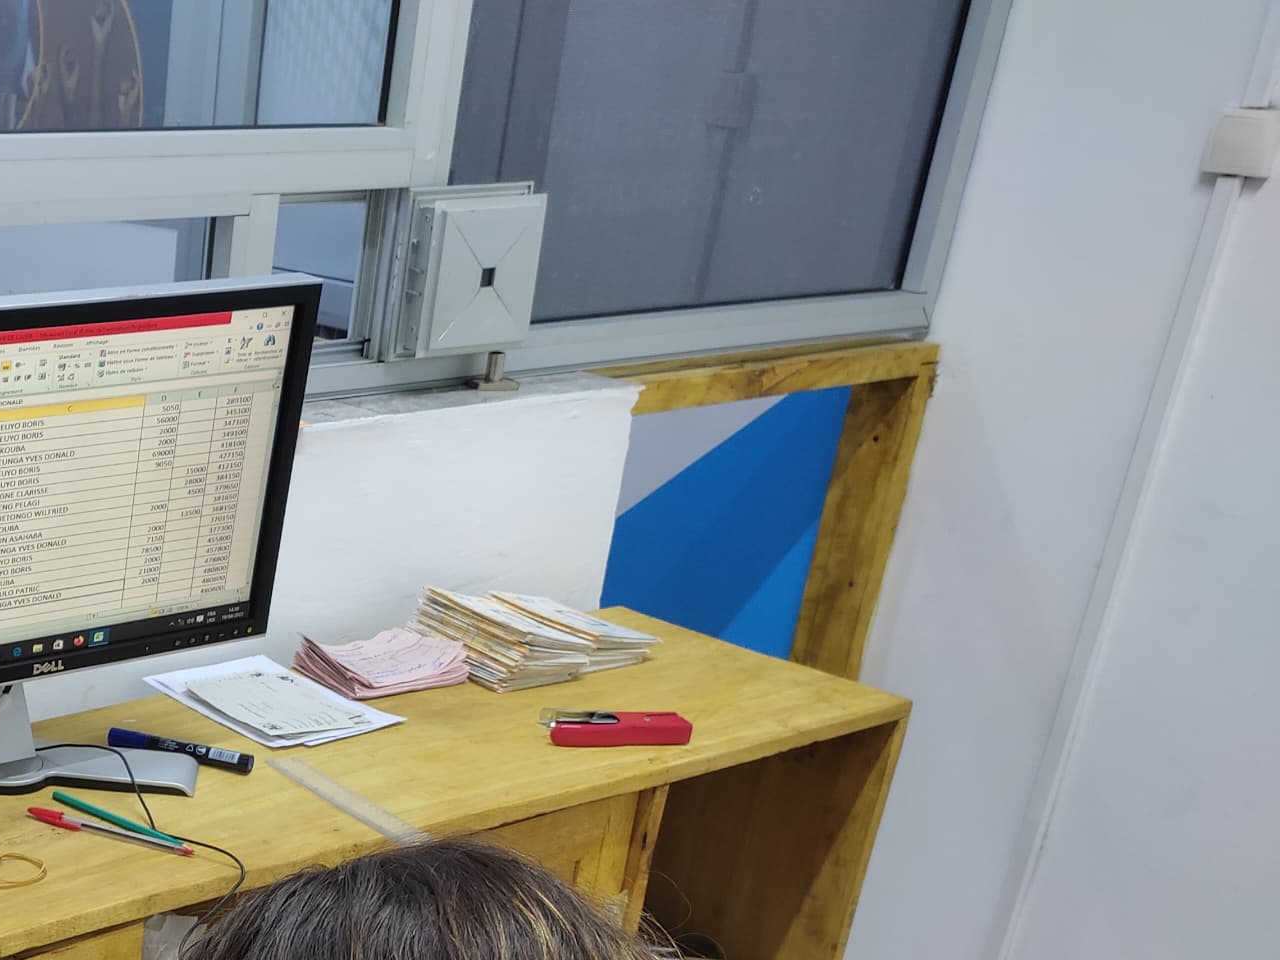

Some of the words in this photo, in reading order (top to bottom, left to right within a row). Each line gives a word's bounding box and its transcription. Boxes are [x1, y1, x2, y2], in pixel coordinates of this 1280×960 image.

[22, 420, 45, 428] BORIS
[22, 432, 44, 440] BORIS
[25, 455, 42, 463] YVES
[44, 450, 75, 460] DONALD
[18, 466, 40, 475] BORIS
[18, 477, 39, 486] BORIS
[15, 500, 40, 509] PELAGI
[34, 506, 68, 517] WILFRIED
[36, 539, 66, 550] DONALD
[11, 555, 33, 564] BORIS
[10, 566, 32, 575] BORIS
[15, 585, 40, 595] PATRIC
[32, 593, 62, 603] DONALD
[32, 660, 64, 675] DELL
